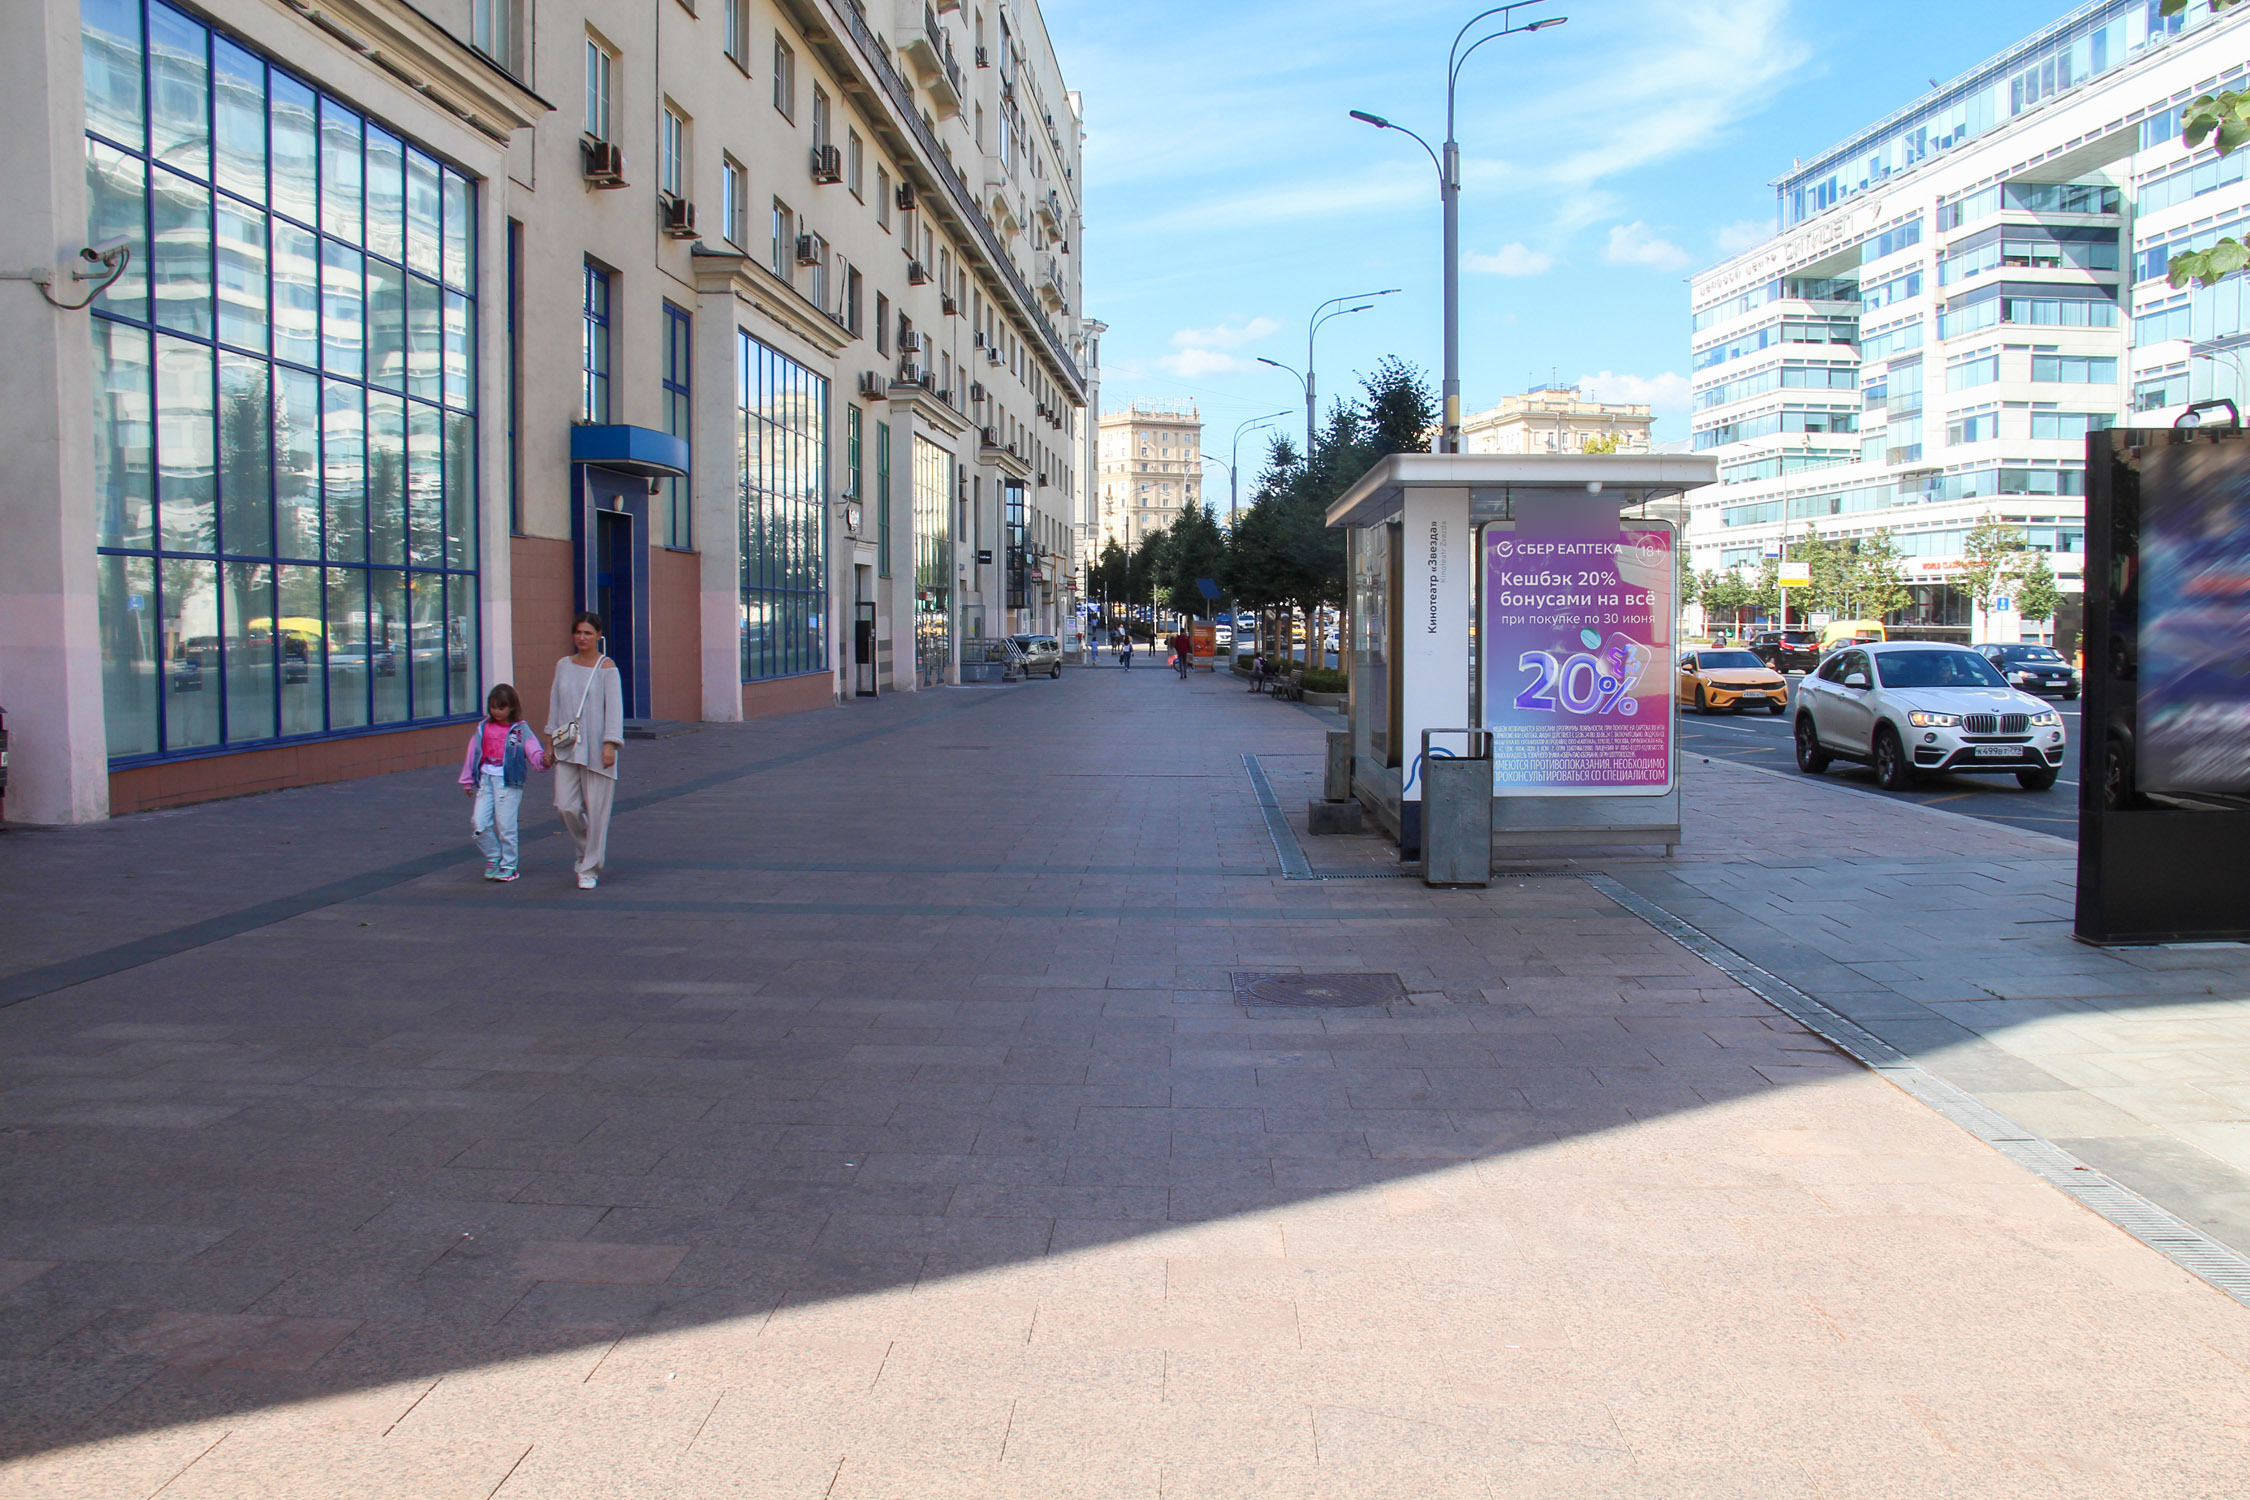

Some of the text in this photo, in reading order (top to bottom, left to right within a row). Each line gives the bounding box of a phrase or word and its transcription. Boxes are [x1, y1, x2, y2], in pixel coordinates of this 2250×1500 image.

[1517, 543, 1623, 555] СБЕР ЕАПТЕКА
[1641, 545, 1662, 557] 18+
[1922, 562, 1941, 570] WORLD
[1427, 521, 1439, 634] Кинотеатр «Звезда»
[1501, 570, 1616, 586] Кешбэк 20%
[1500, 590, 1656, 609] бонусами на всё
[1501, 613, 1656, 626] при покупке по 30 июня
[1513, 650, 1638, 716] 20%
[1494, 757, 1665, 771] ИМЕЮТСЯ ПРОТИВОПОКАЗАНИЯ. НЕОБХОДИМО
[1495, 769, 1665, 782] ПРОКОНСУЛЬТИРОВАТЬСЯ СО СПЕЦИАЛИСТОМ
